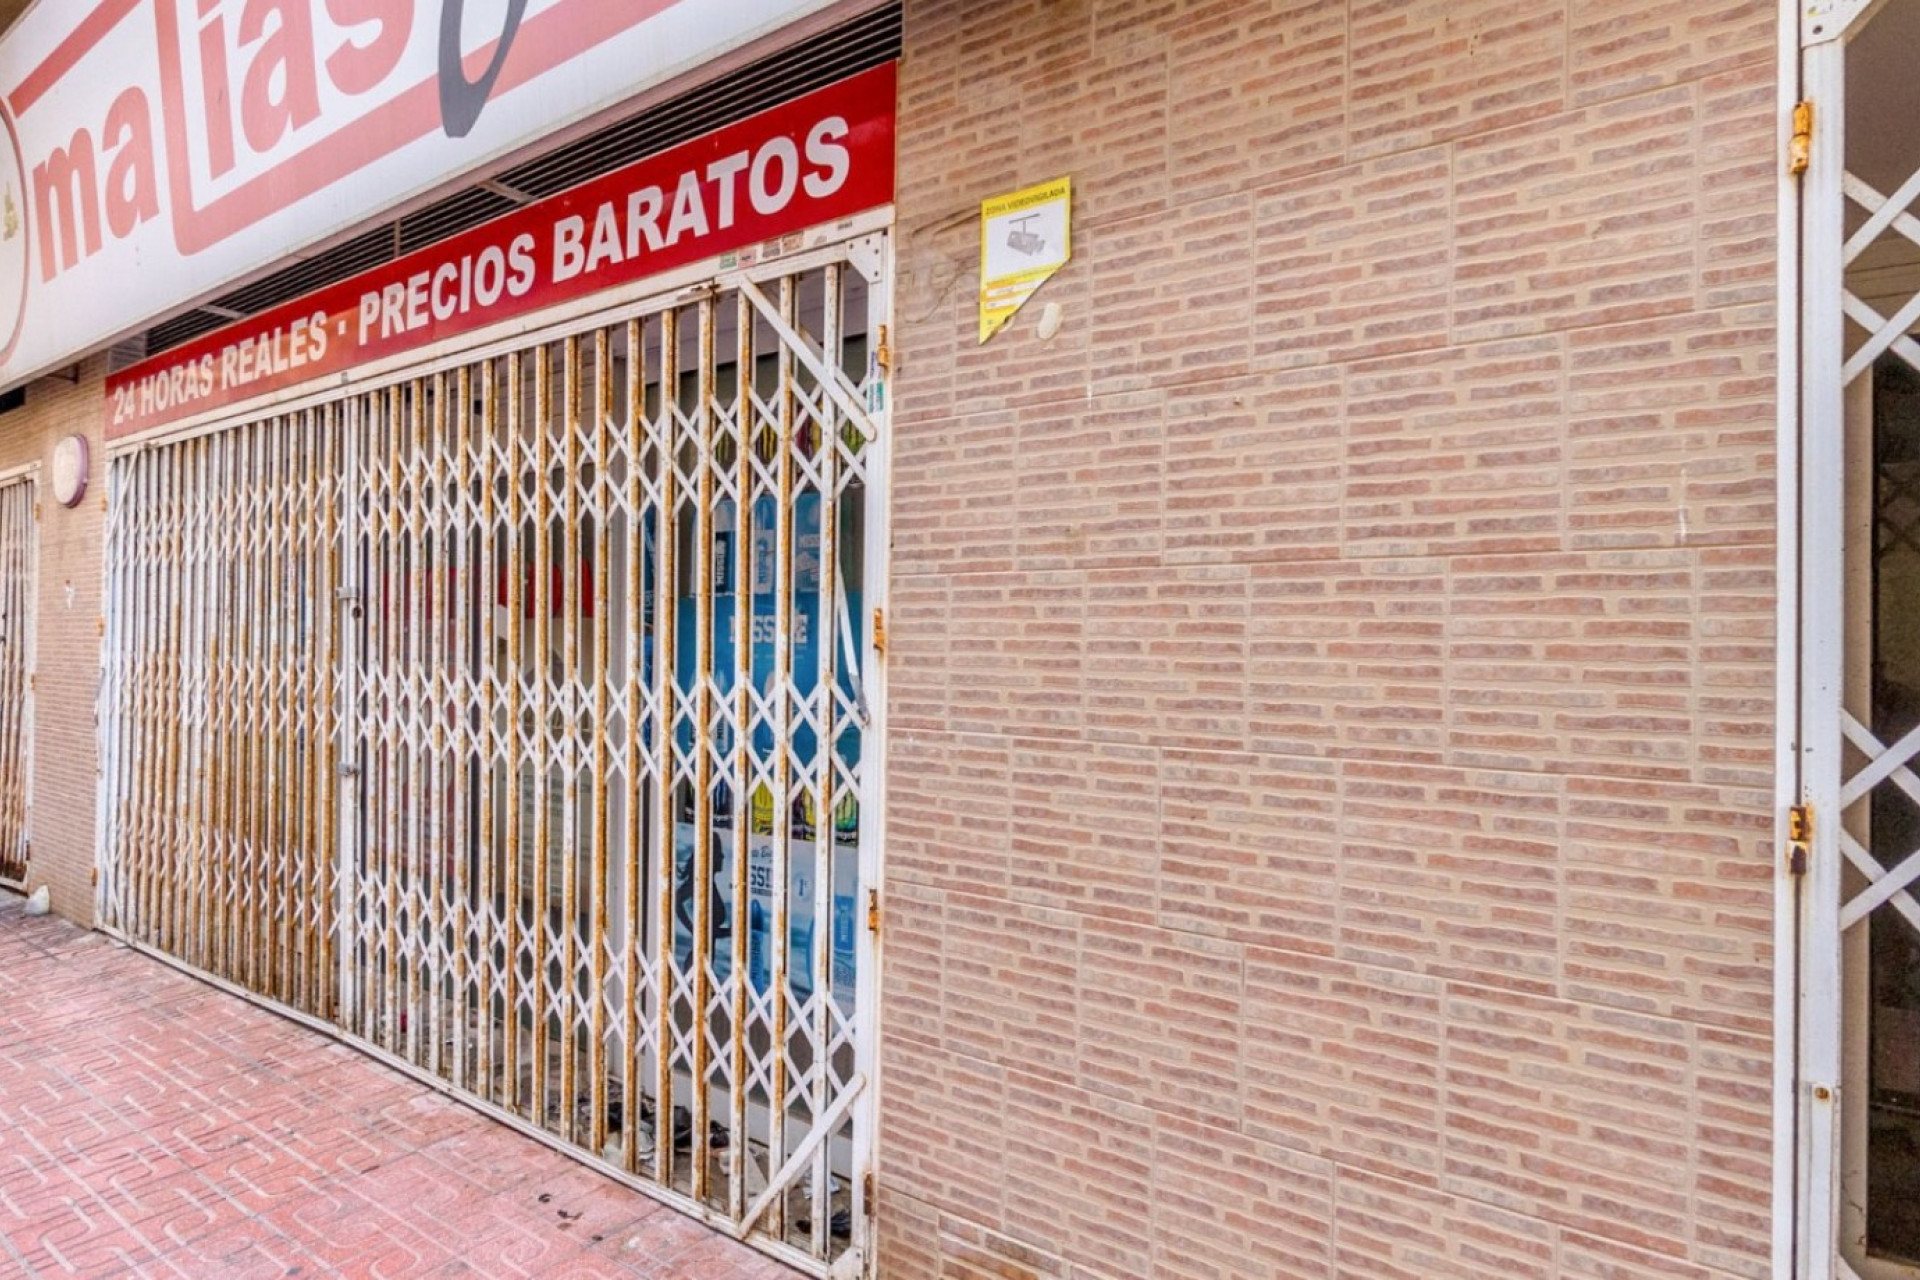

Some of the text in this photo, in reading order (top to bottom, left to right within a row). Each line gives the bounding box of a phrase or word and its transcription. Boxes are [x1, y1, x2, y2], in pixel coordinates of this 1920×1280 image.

[112, 382, 136, 425] 24
[141, 353, 213, 417] HORAS
[222, 310, 327, 388] REALES
[358, 234, 535, 345] PRECIOS
[552, 115, 850, 284] BARATOS
